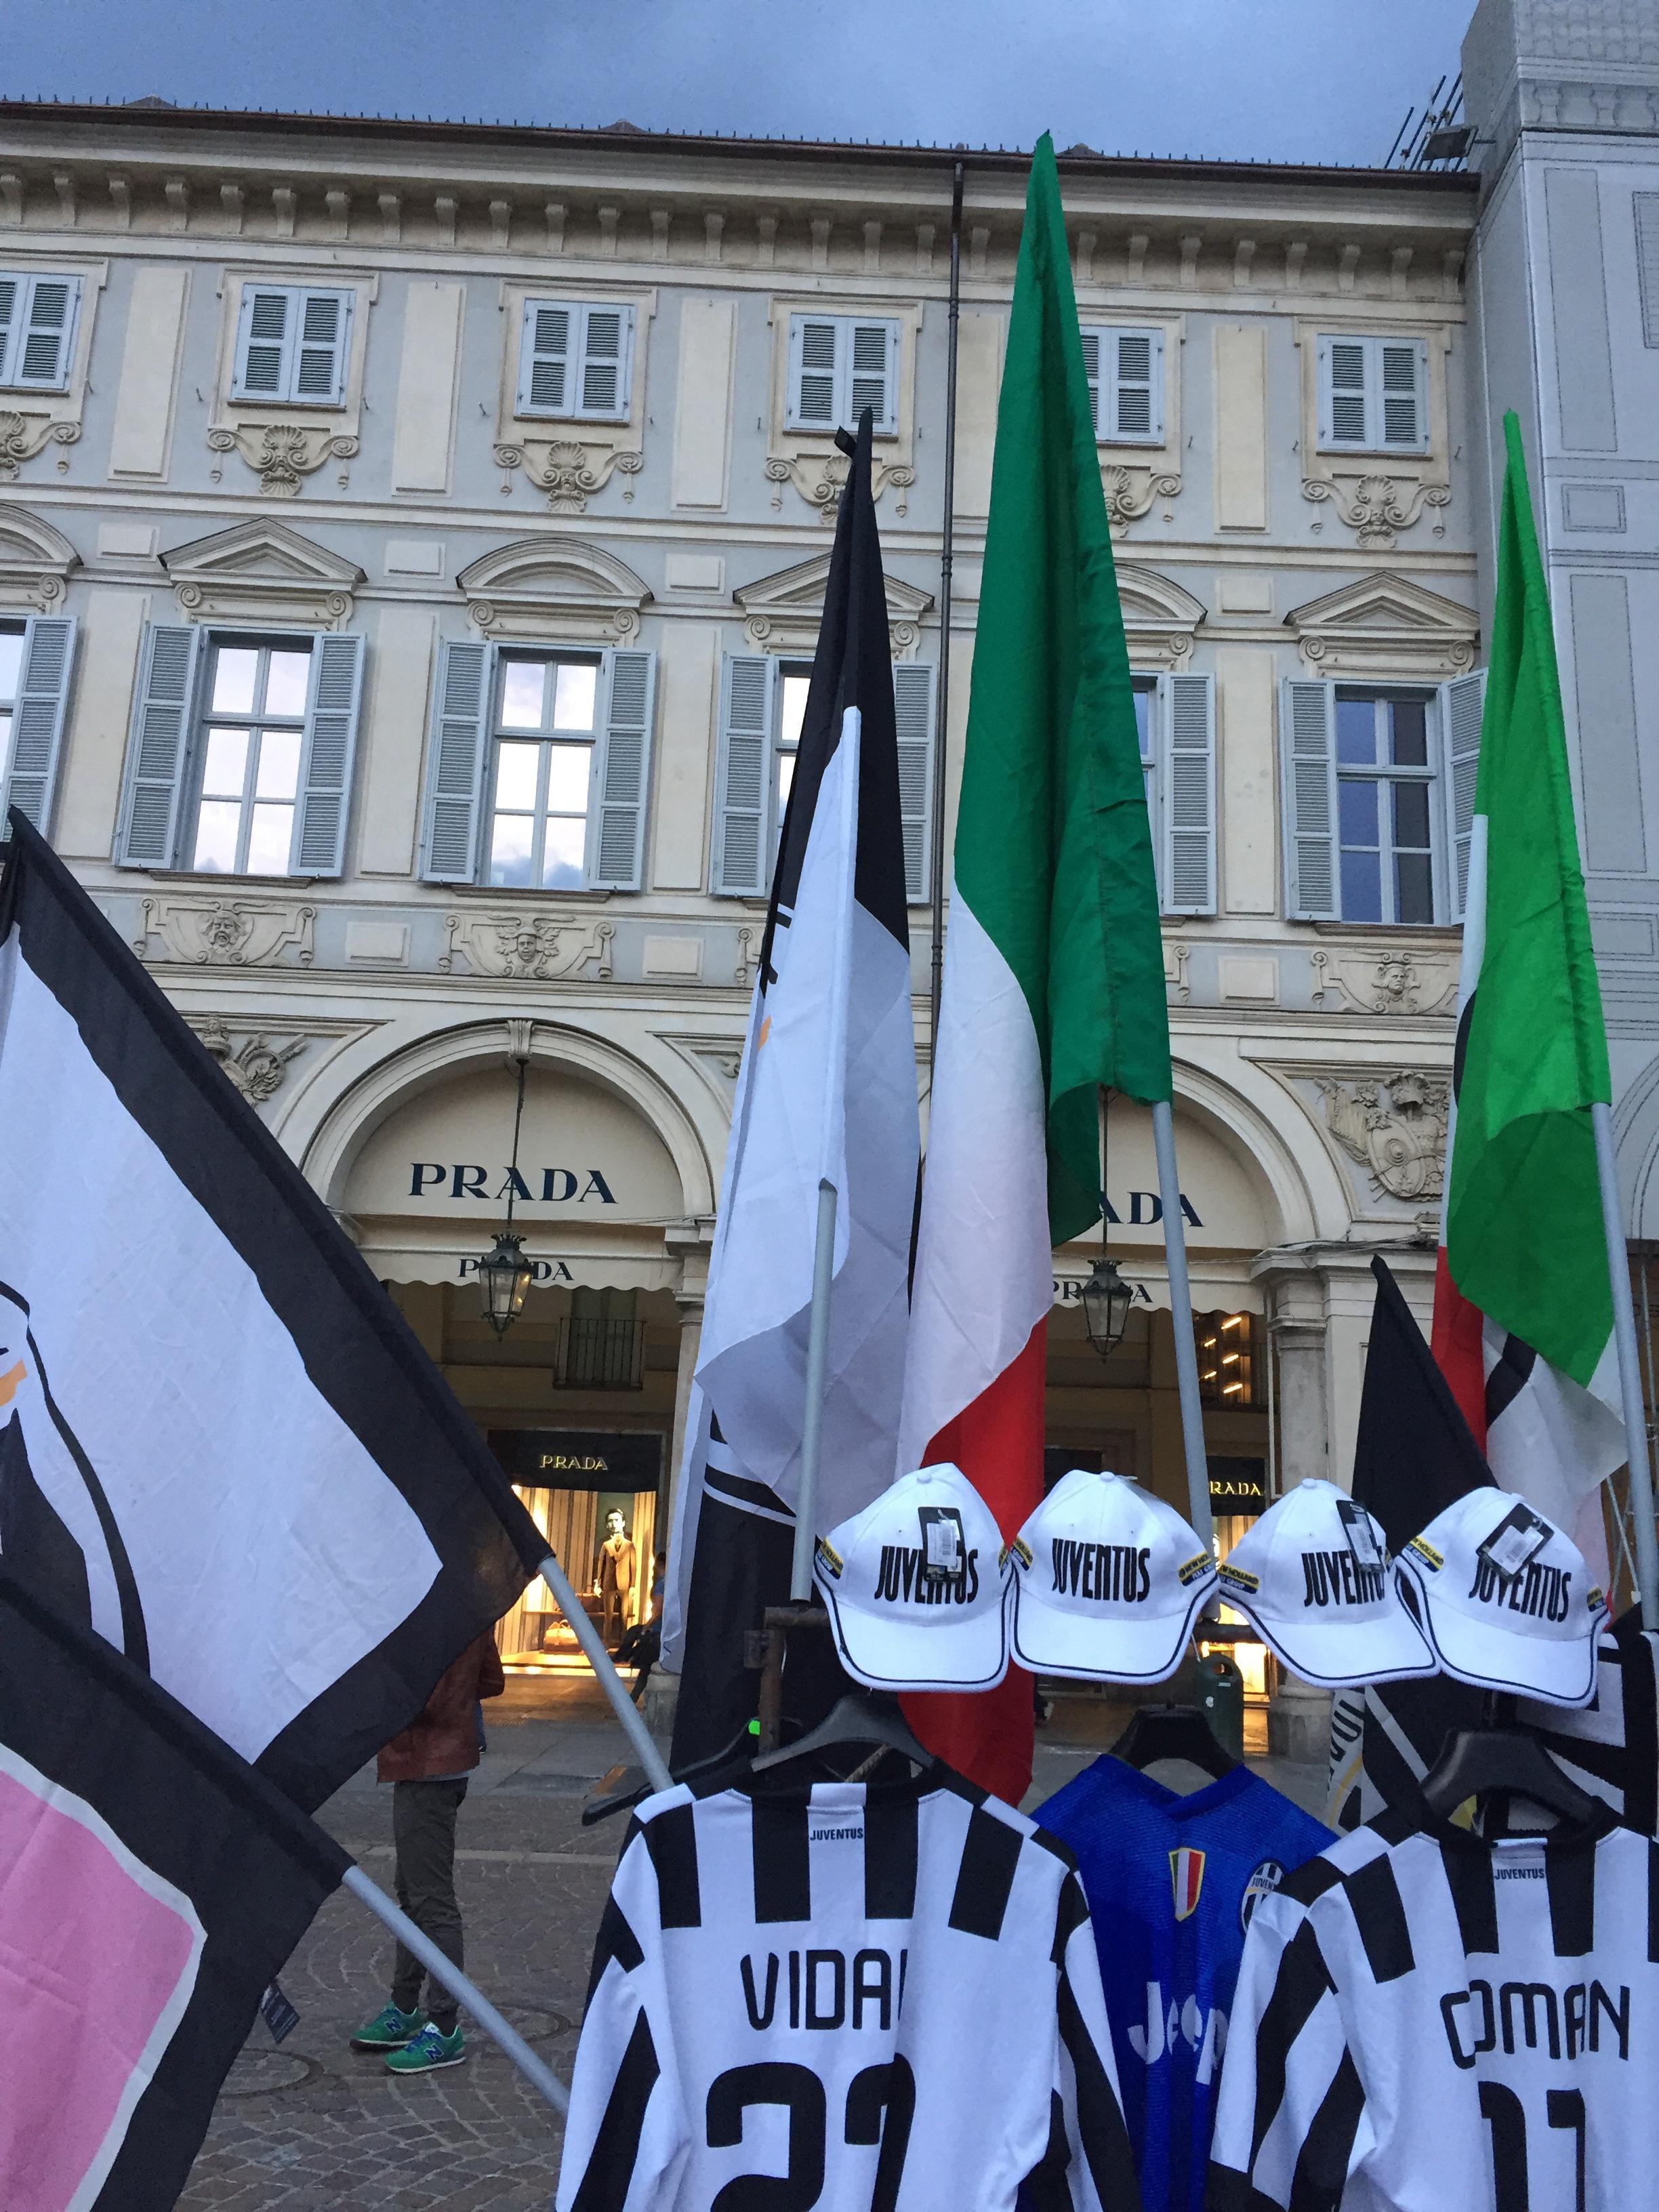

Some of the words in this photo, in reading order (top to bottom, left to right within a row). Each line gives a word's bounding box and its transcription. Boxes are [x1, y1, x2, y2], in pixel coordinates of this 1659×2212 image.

[408, 1162, 619, 1204] PRADA
[1099, 1191, 1206, 1227] ADA
[458, 1258, 575, 1281] PDA
[539, 1454, 609, 1471] PRADA
[1209, 1480, 1264, 1496] RADA
[1052, 1538, 1151, 1603] JUVENTUS
[810, 1828, 864, 1841] JUVENTUS
[1494, 1868, 1545, 1880] JUVENTUS
[740, 1948, 908, 2031] VIDA
